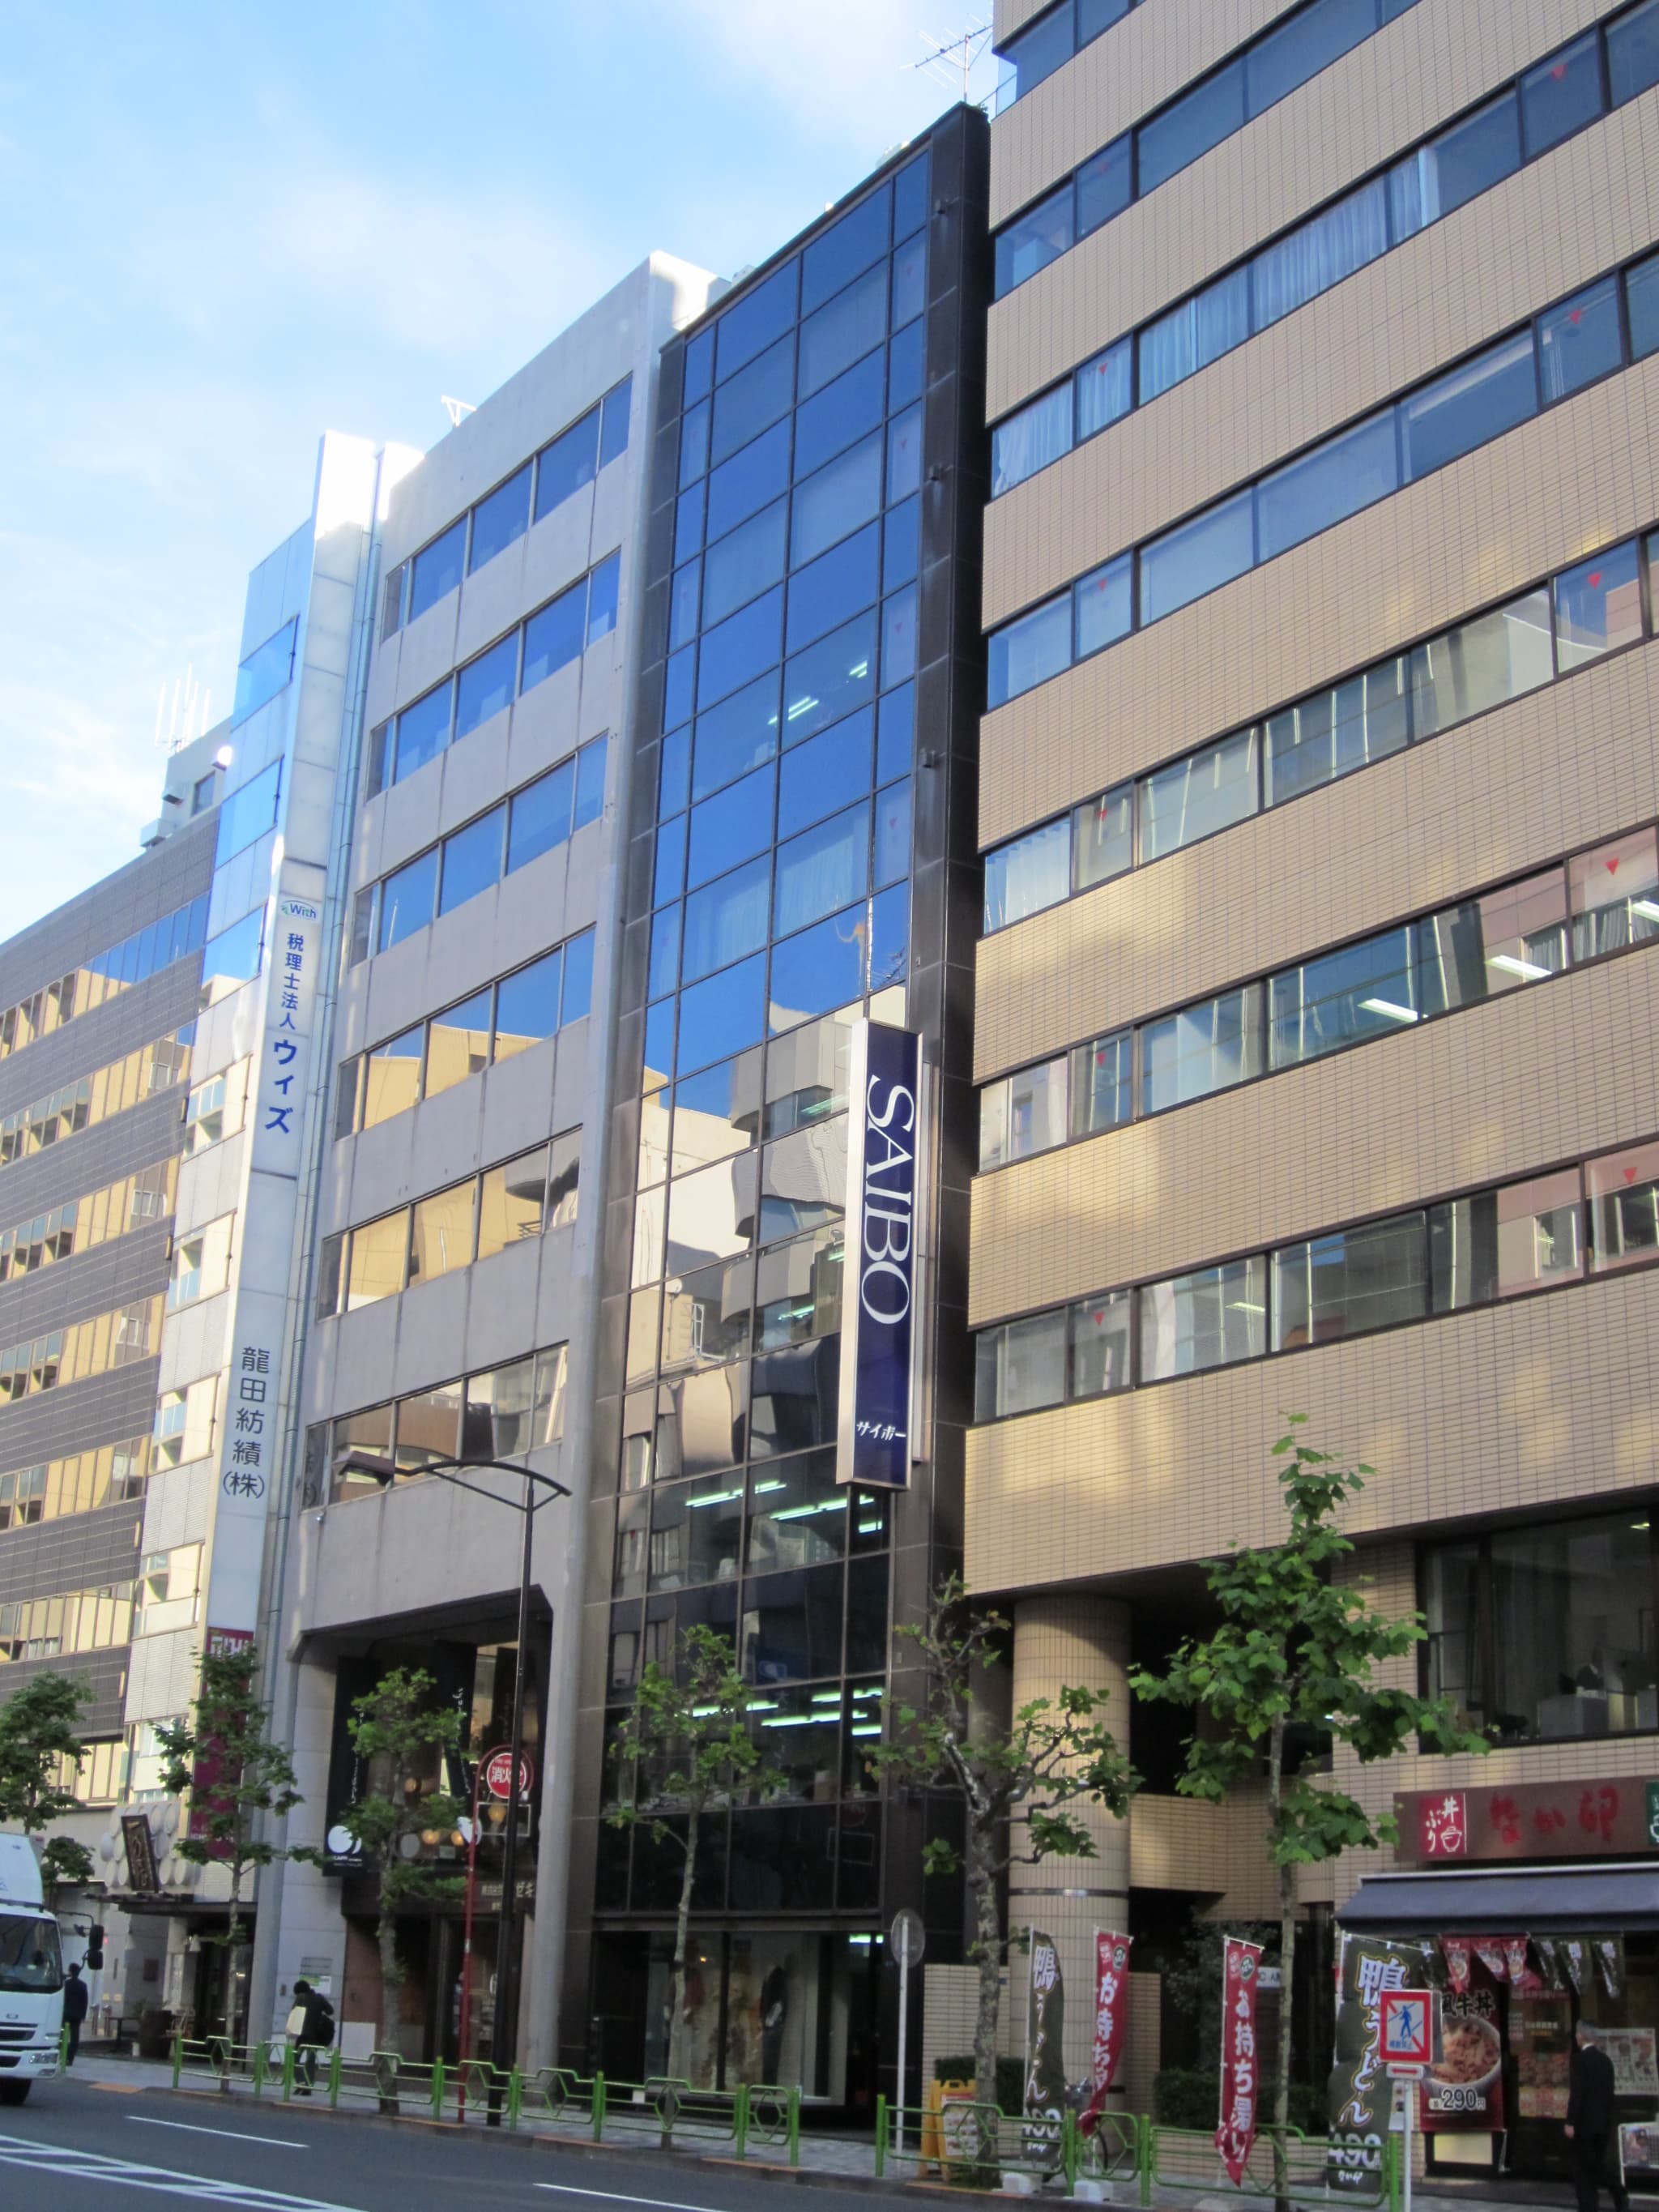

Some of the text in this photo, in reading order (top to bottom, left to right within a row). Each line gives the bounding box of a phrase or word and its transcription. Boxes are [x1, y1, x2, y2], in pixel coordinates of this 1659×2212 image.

[290, 901, 317, 919] With
[862, 1074, 915, 1324] SAIBO
[855, 1420, 906, 1441] サイボー
[491, 1766, 523, 1785] 消火
